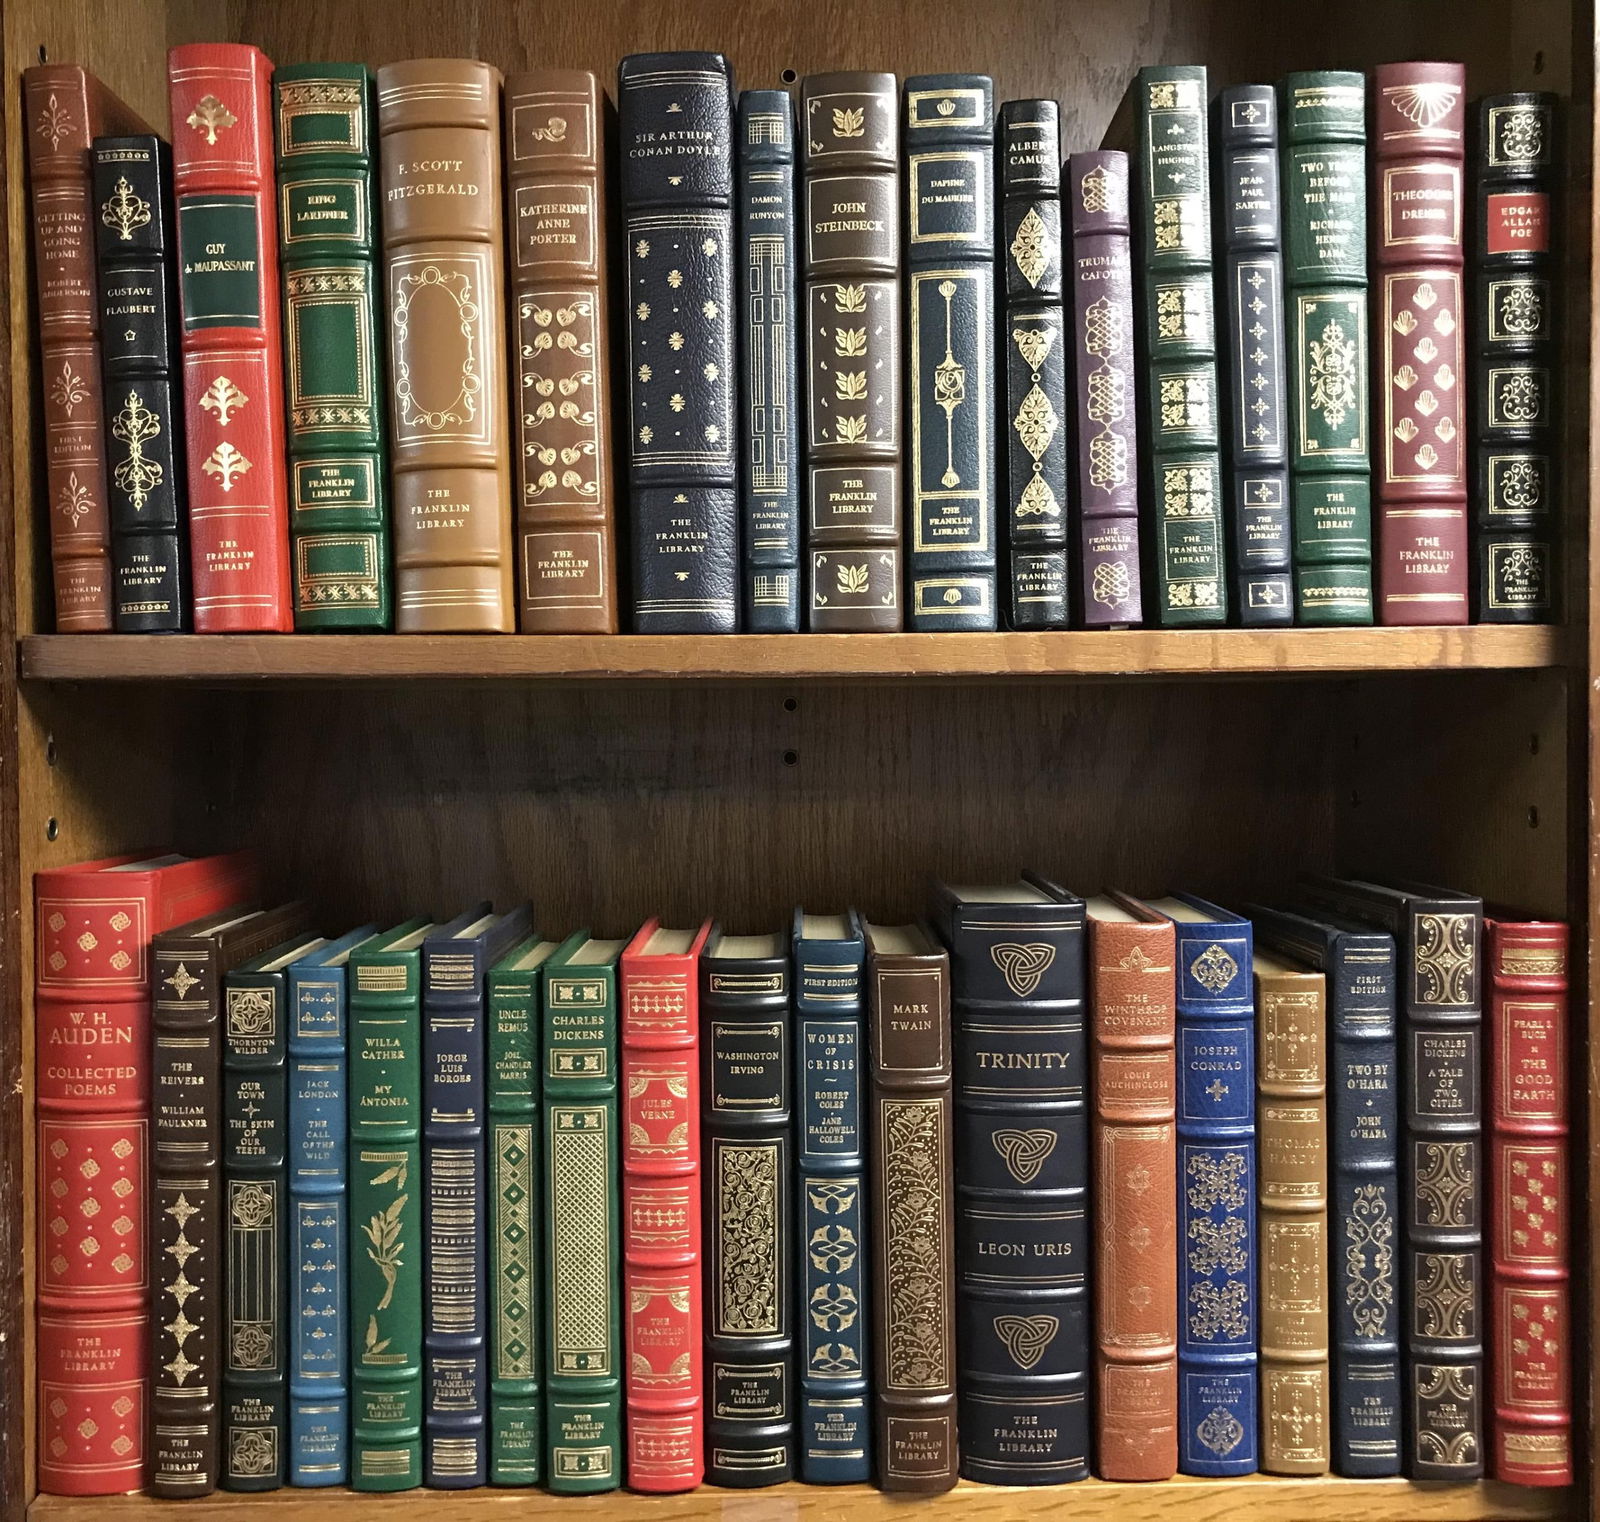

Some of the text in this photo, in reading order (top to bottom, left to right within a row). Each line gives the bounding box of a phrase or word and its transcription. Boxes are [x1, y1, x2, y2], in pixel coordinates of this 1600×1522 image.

[636, 131, 713, 143] SIR ARTHUR
[630, 146, 719, 158] CONAN DOYLE
[399, 161, 463, 175] F. SCOTT
[1301, 163, 1323, 173] TWO
[388, 185, 479, 201] FITZGERALD
[922, 196, 934, 204] DU
[1304, 194, 1325, 203] THE
[520, 204, 588, 217] KATHERINE
[832, 203, 865, 213] JOHN
[38, 212, 85, 222] GETTING
[537, 219, 570, 229] ANNE
[815, 221, 884, 233] STEINBECK
[41, 225, 82, 234] UP AND
[1511, 229, 1532, 237] POE
[44, 238, 80, 246] GOING
[530, 234, 576, 244] PORTER
[206, 244, 226, 254] GUY
[46, 251, 79, 259] HOME
[195, 261, 255, 272] MAUPASSANT
[108, 288, 153, 296] GUSTAVE
[107, 306, 156, 315] FLAUBERT
[309, 480, 354, 488] FRANKLIN
[843, 480, 863, 488] THE
[312, 488, 352, 497] LIBRARY
[829, 492, 877, 501] FRANKLIN
[1327, 493, 1344, 501] THE
[411, 504, 470, 515] FRANKLIN
[833, 505, 874, 514] LIBRARY
[1314, 507, 1356, 515] FRANKLIN
[417, 519, 464, 529] LIBRARY
[656, 531, 708, 540] FRANKLIN
[933, 528, 969, 536] LIBRARY
[1416, 537, 1439, 546] THE
[659, 545, 704, 553] LIBRARY
[1170, 545, 1212, 554] FRANKLIN
[1400, 551, 1454, 560] FRANKLIN
[538, 560, 589, 569] FRANKLIN
[1406, 564, 1449, 573] LIBRARY
[121, 566, 166, 574] FRANKLIN
[542, 570, 585, 578] LIBRARY
[124, 577, 162, 585] LIBRARY
[804, 978, 858, 987] FIRST EDITION
[1356, 976, 1381, 984] FIRST
[1351, 986, 1386, 994] EDITION
[894, 1005, 928, 1014] MARK
[70, 1013, 111, 1024] W. H.
[499, 1010, 527, 1019] UNCLE
[552, 1016, 604, 1025] CHARLES
[1514, 1020, 1543, 1028] PEARL
[498, 1023, 528, 1032] REMUS
[891, 1021, 932, 1030] TWAIN
[51, 1027, 132, 1044] AUDEN
[554, 1030, 604, 1040] DICKENS
[808, 1034, 854, 1044] WOMEN
[1521, 1031, 1546, 1039] BUCK
[1424, 1040, 1466, 1048] CHARLES
[362, 1051, 405, 1059] CATHER
[825, 1047, 836, 1055] OF
[1194, 1047, 1238, 1055] JOSEPH
[1425, 1049, 1465, 1058] DICKENS
[437, 1054, 467, 1062] JORGE
[717, 1051, 779, 1061] WASHINGTON
[976, 1052, 1070, 1068] TRINITY
[171, 1063, 192, 1071] THE
[496, 1061, 531, 1069] CHANDLER
[808, 1060, 854, 1070] CRISIS
[1191, 1061, 1241, 1070] CONRAD
[1522, 1059, 1546, 1069] THE
[48, 1067, 137, 1079] COLLECTED
[730, 1066, 764, 1074] IRVING
[1348, 1065, 1387, 1075] TWO BY
[1428, 1069, 1463, 1077] A TALE
[1515, 1075, 1553, 1084] GOOD
[241, 1082, 260, 1090] OUR
[1347, 1079, 1388, 1090] O'HARA
[65, 1084, 116, 1095] POEMS
[1434, 1089, 1458, 1097] TWO
[237, 1091, 264, 1099] TOWN
[815, 1091, 849, 1100] ROBERT
[1513, 1090, 1555, 1100] EARTH
[643, 1099, 672, 1108] JULES
[819, 1101, 844, 1109] COLES
[1430, 1099, 1463, 1108] CITIES
[162, 1106, 204, 1114] WILLIAM
[640, 1111, 675, 1119] VERNE
[230, 1120, 274, 1128] THE SKIN
[822, 1117, 842, 1125] JANE
[1356, 1116, 1381, 1127] JOHN
[244, 1129, 256, 1137] OF
[809, 1125, 855, 1134] HALLOWELL
[1351, 1129, 1387, 1139] O'HARA
[241, 1138, 260, 1146] OUR
[819, 1135, 844, 1143] COLES
[236, 1146, 265, 1155] TEETH
[978, 1242, 1072, 1256] LEON URIS
[77, 1338, 101, 1346] THE
[1013, 1416, 1038, 1424] THE
[994, 1428, 1057, 1438] FRANKLIN
[1000, 1443, 1052, 1452] LIBRARY
